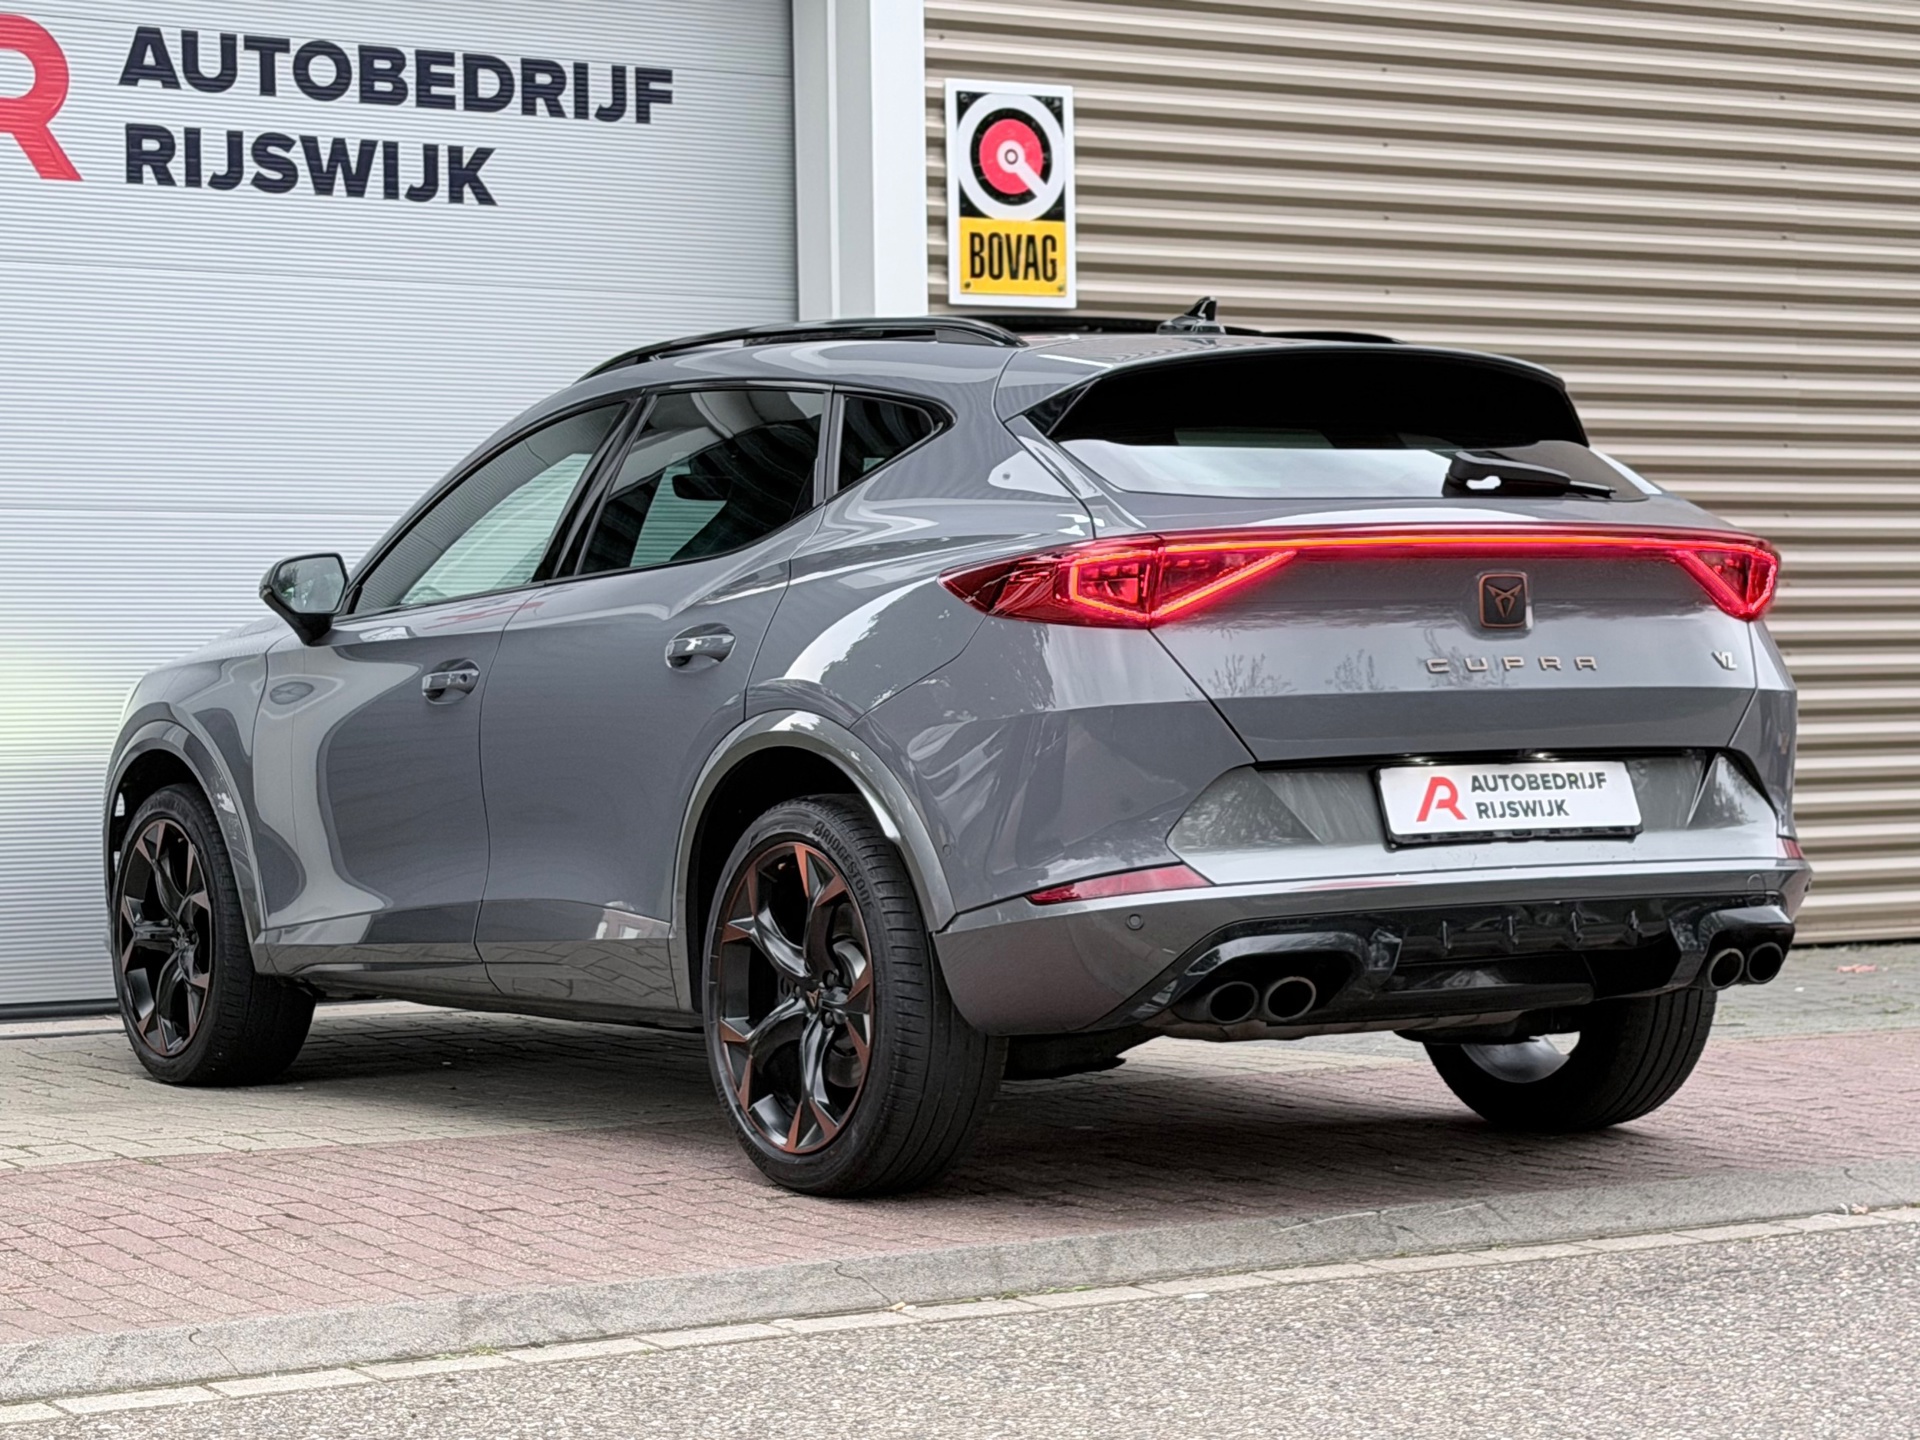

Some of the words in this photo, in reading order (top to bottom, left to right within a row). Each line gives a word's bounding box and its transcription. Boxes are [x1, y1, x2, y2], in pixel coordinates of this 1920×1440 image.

[119, 26, 673, 125] AUTOBEDRIJF
[125, 122, 498, 207] RIJSWIJK
[969, 232, 1058, 282] BOVAG
[1425, 655, 1598, 674] CUPRA
[1471, 772, 1607, 793] AUTOBEDRIJF
[1475, 799, 1569, 819] RIJSWIJK
[812, 820, 875, 908] BRIDGESTONE
